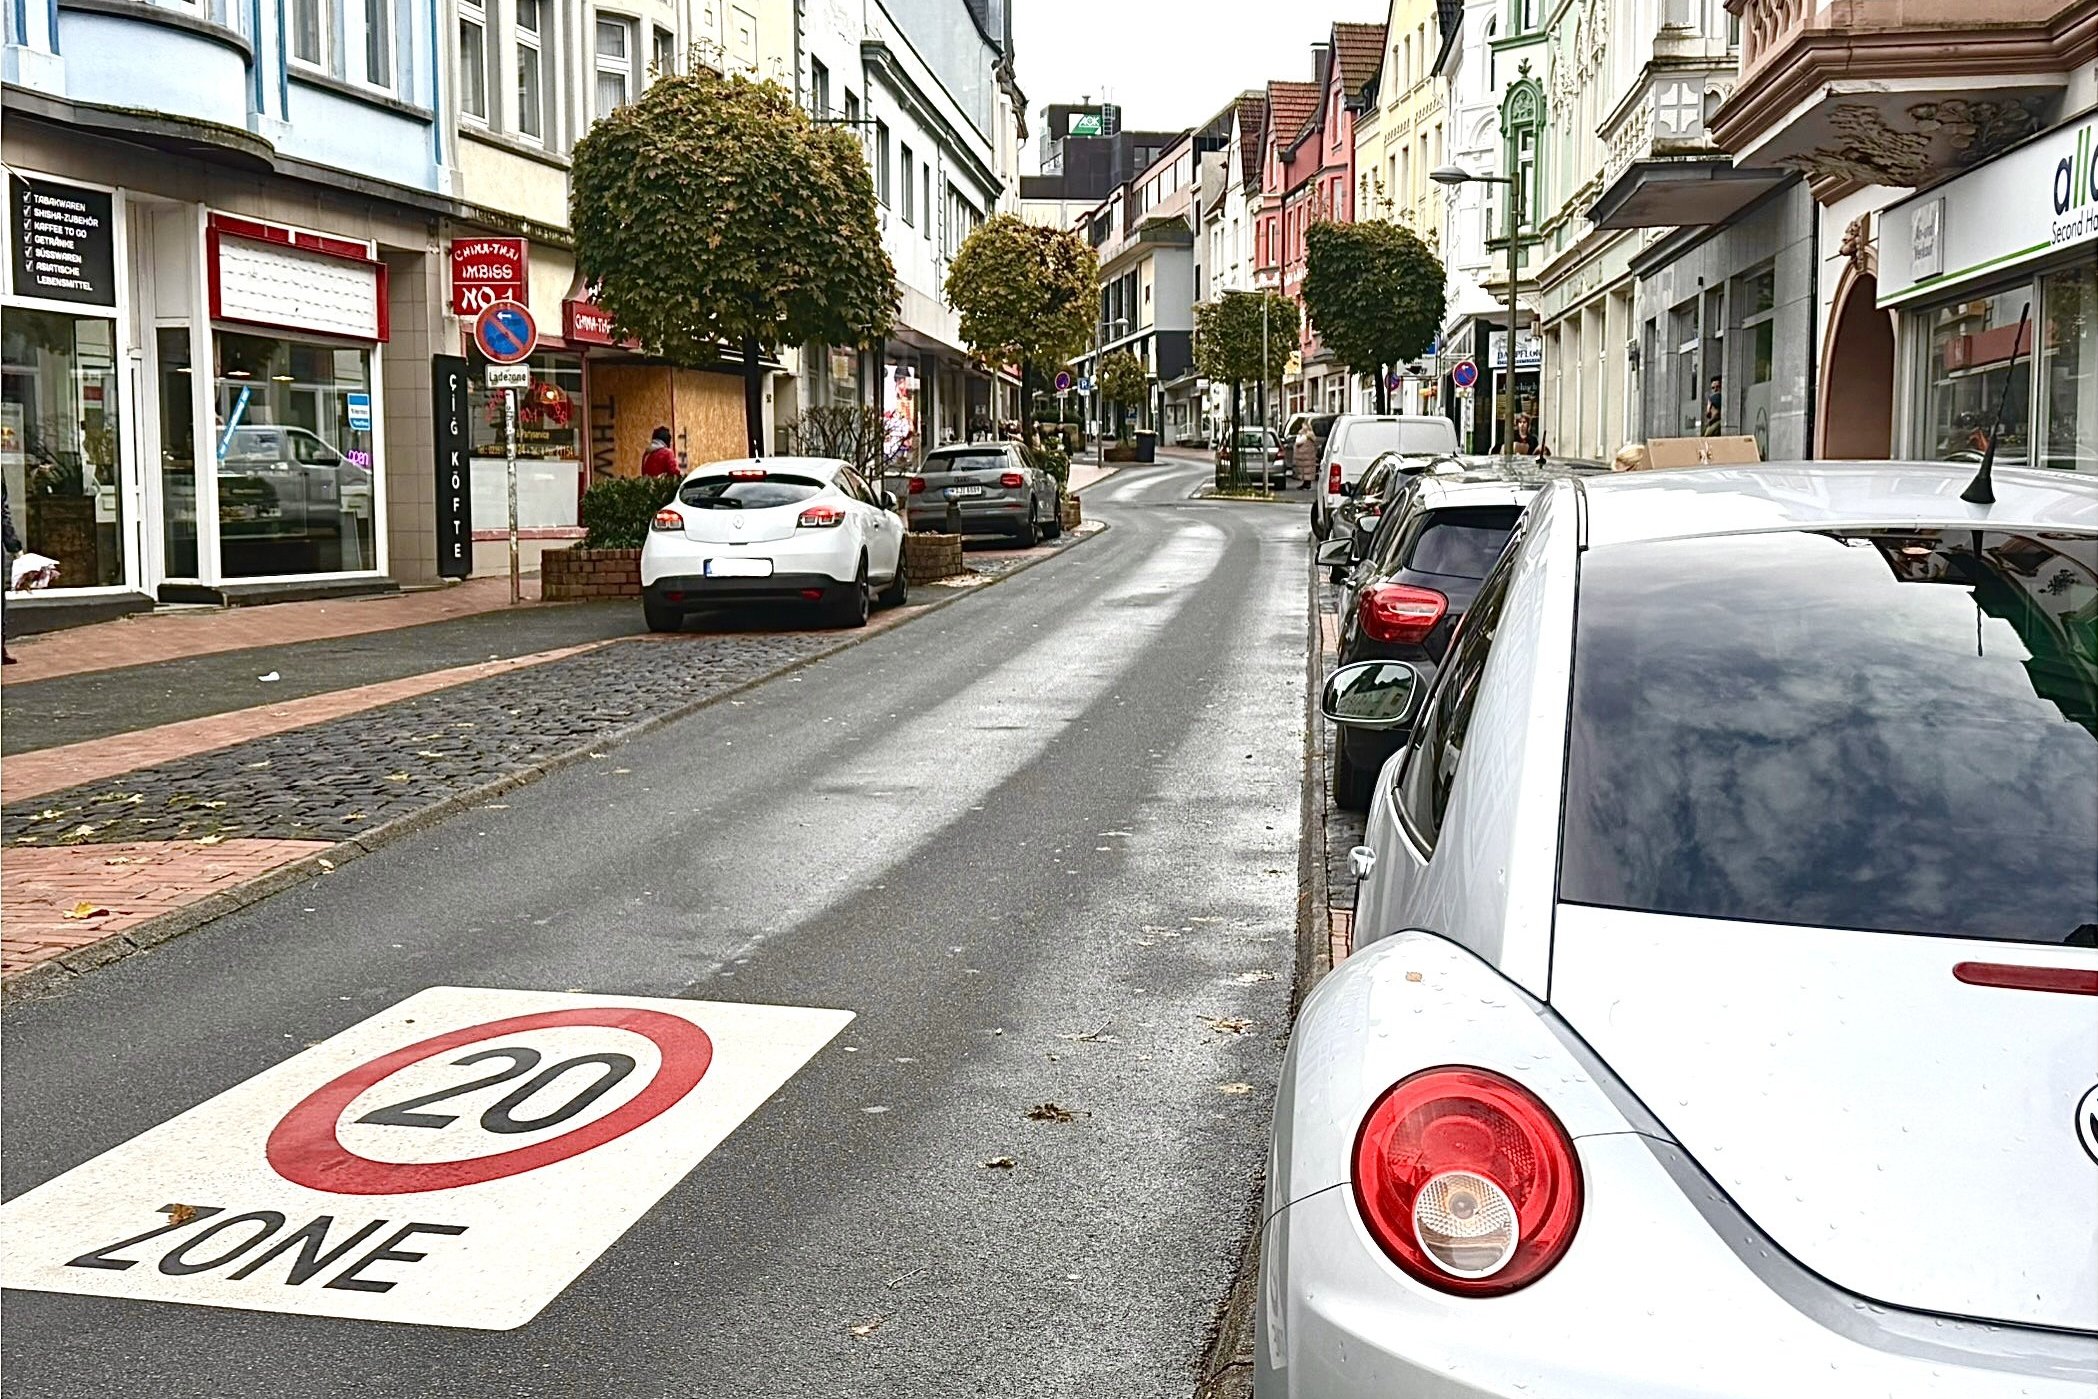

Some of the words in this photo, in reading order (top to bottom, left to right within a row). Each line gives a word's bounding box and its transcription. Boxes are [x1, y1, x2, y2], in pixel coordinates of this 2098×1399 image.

[33, 194, 86, 212] TABAKWAREN
[33, 208, 99, 227] SHISHA-ZUBEHÖR
[33, 221, 63, 235] KAFFEE
[64, 226, 75, 236] TO
[75, 228, 87, 239] GO
[2051, 209, 2083, 245] Second
[34, 234, 75, 250] GETRÄNKE
[35, 246, 82, 264] SÜSSWAREN
[455, 243, 519, 261] CHINA-THAI
[36, 261, 80, 277] ASIATISCHE
[462, 264, 513, 279] IMBISS
[36, 274, 93, 291] LEBENSMITTEL
[461, 286, 496, 310] NO
[489, 372, 526, 382] Ladezone
[1081, 380, 1088, 389] P
[451, 451, 462, 558] KÖFTE
[355, 1046, 637, 1135] 20
[65, 1202, 470, 1294] ZONE
